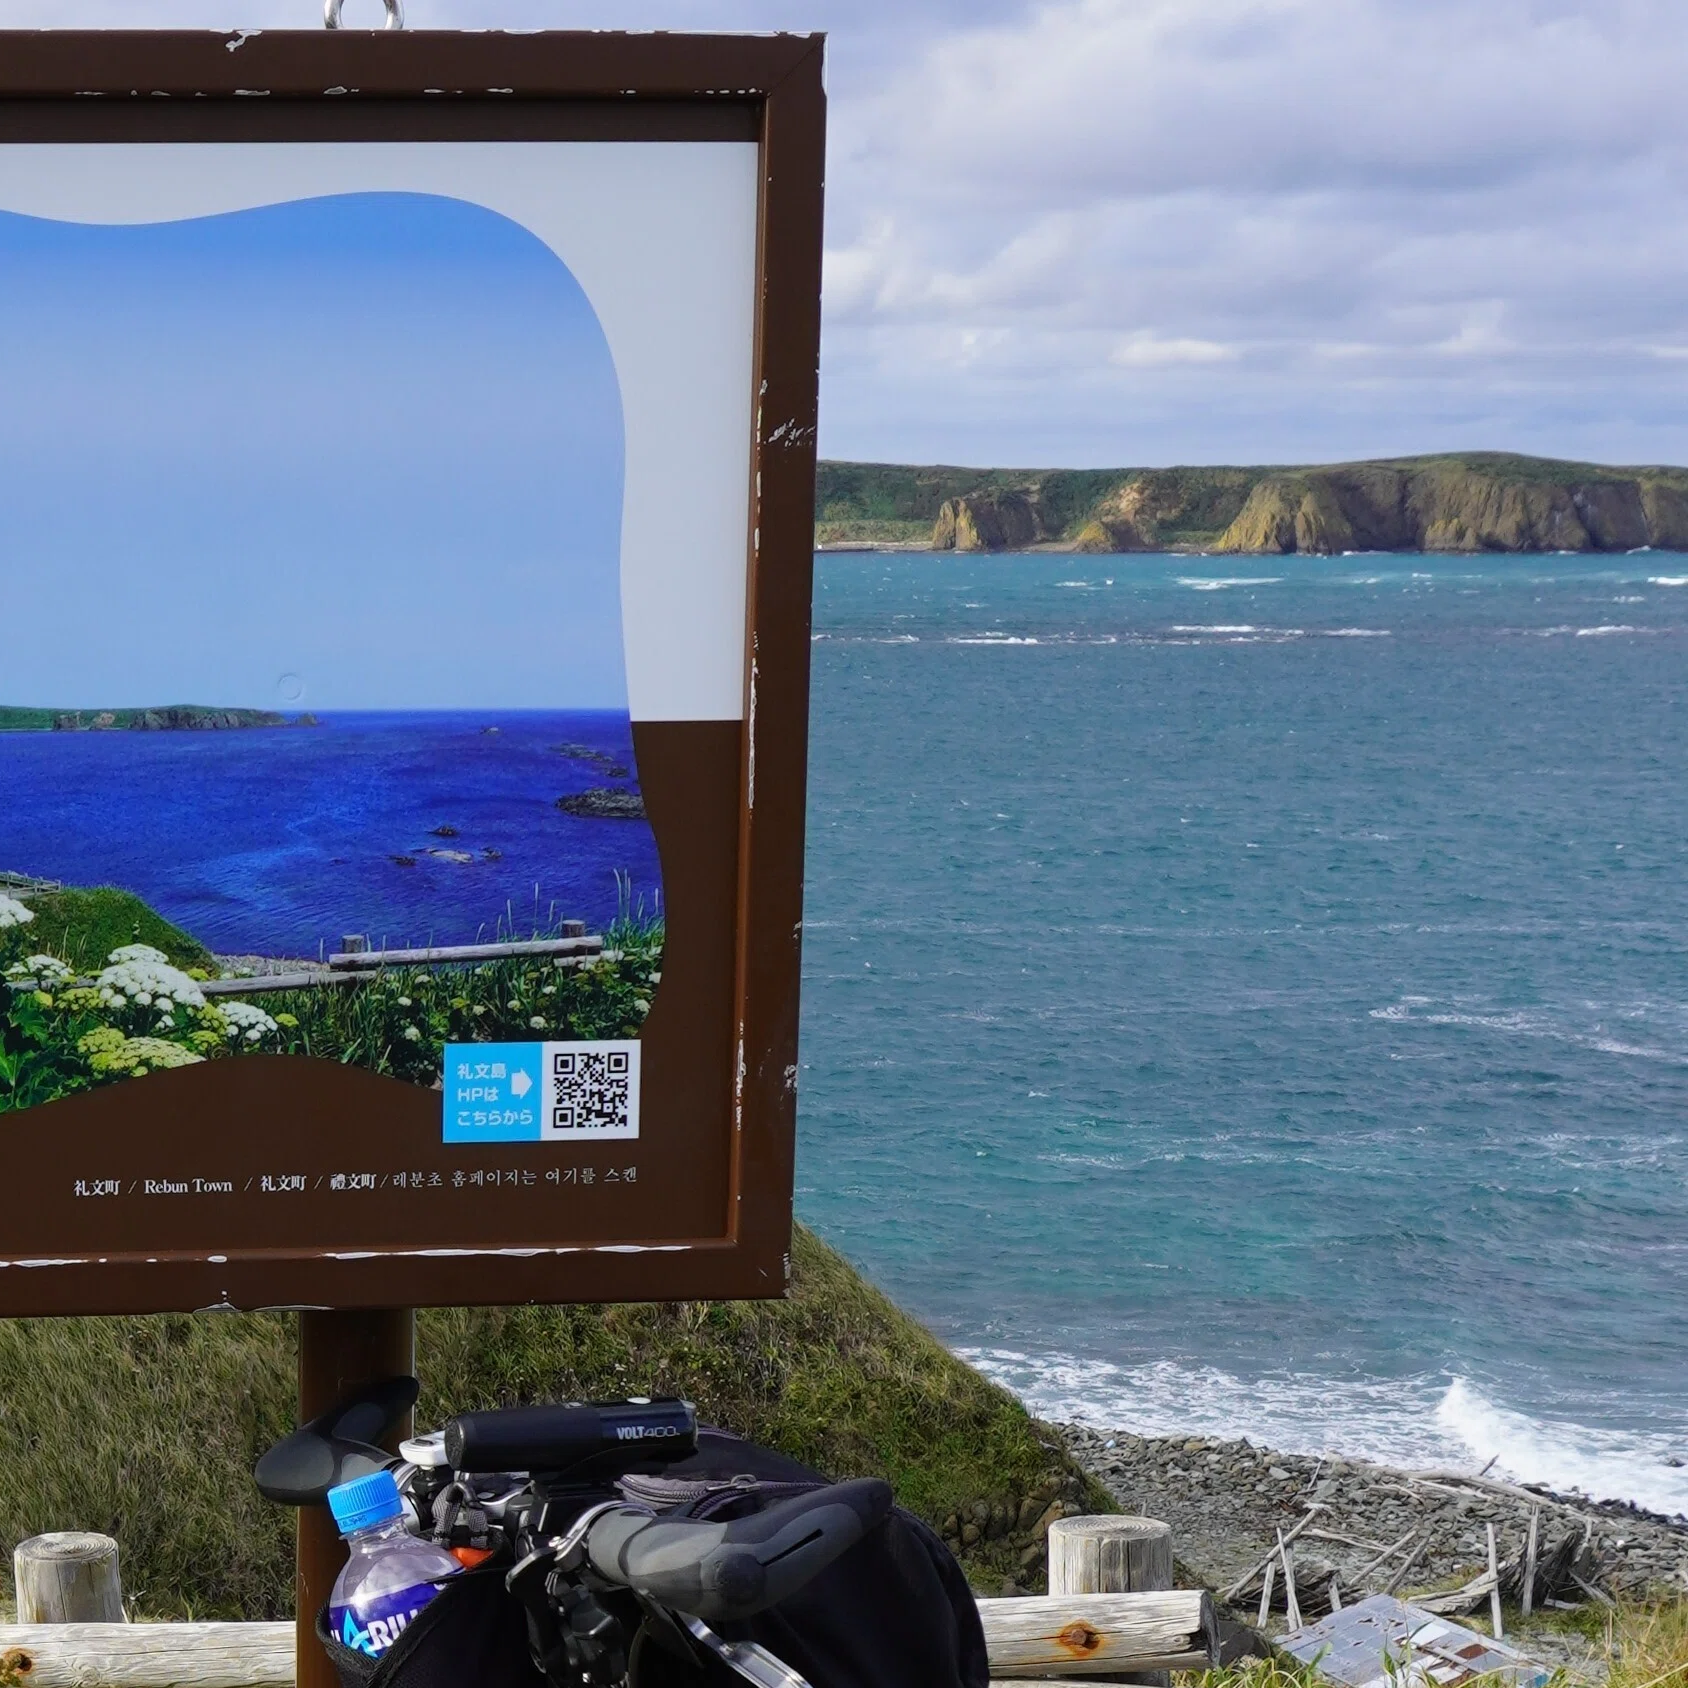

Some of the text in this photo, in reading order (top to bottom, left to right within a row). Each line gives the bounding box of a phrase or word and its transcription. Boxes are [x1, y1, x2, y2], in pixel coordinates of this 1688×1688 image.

[457, 1062, 507, 1080] 礼文島
[457, 1086, 499, 1102] HPは
[457, 1109, 533, 1126] こちらから
[73, 1178, 121, 1197] 礼文町
[143, 1178, 189, 1194] Rebun
[192, 1177, 233, 1193] Town
[260, 1174, 307, 1193] 礼文町
[392, 1171, 443, 1189] 레분초
[451, 1169, 537, 1188] 홈페이지는
[545, 1167, 596, 1186] 여기를
